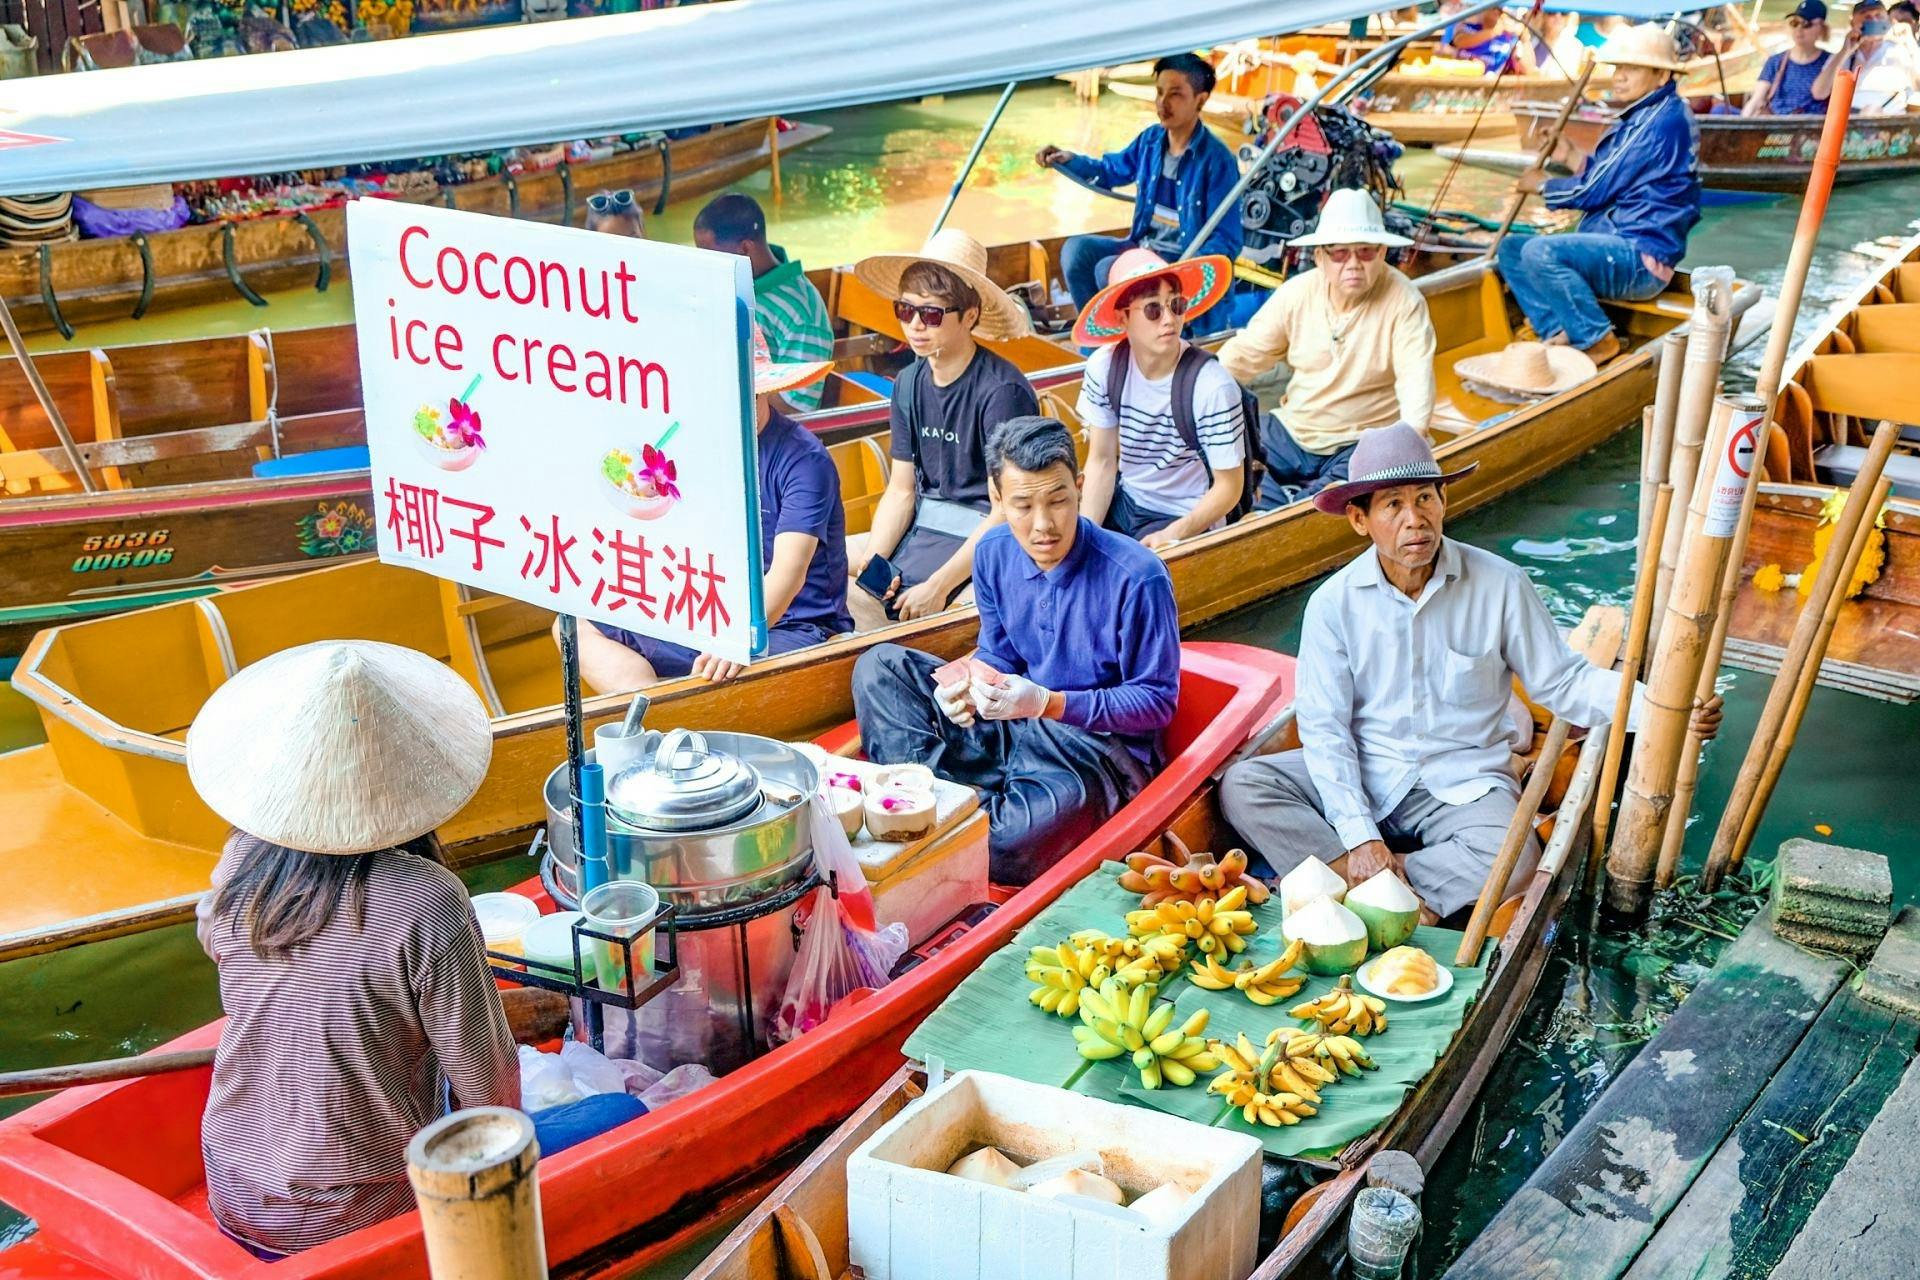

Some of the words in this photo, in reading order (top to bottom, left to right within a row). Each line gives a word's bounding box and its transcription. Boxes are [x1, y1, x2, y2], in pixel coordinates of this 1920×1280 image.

[399, 225, 639, 324] Coconut
[388, 298, 464, 371] ice
[492, 333, 670, 414] cream
[72, 547, 175, 573] 00606
[82, 529, 170, 551] 5836
